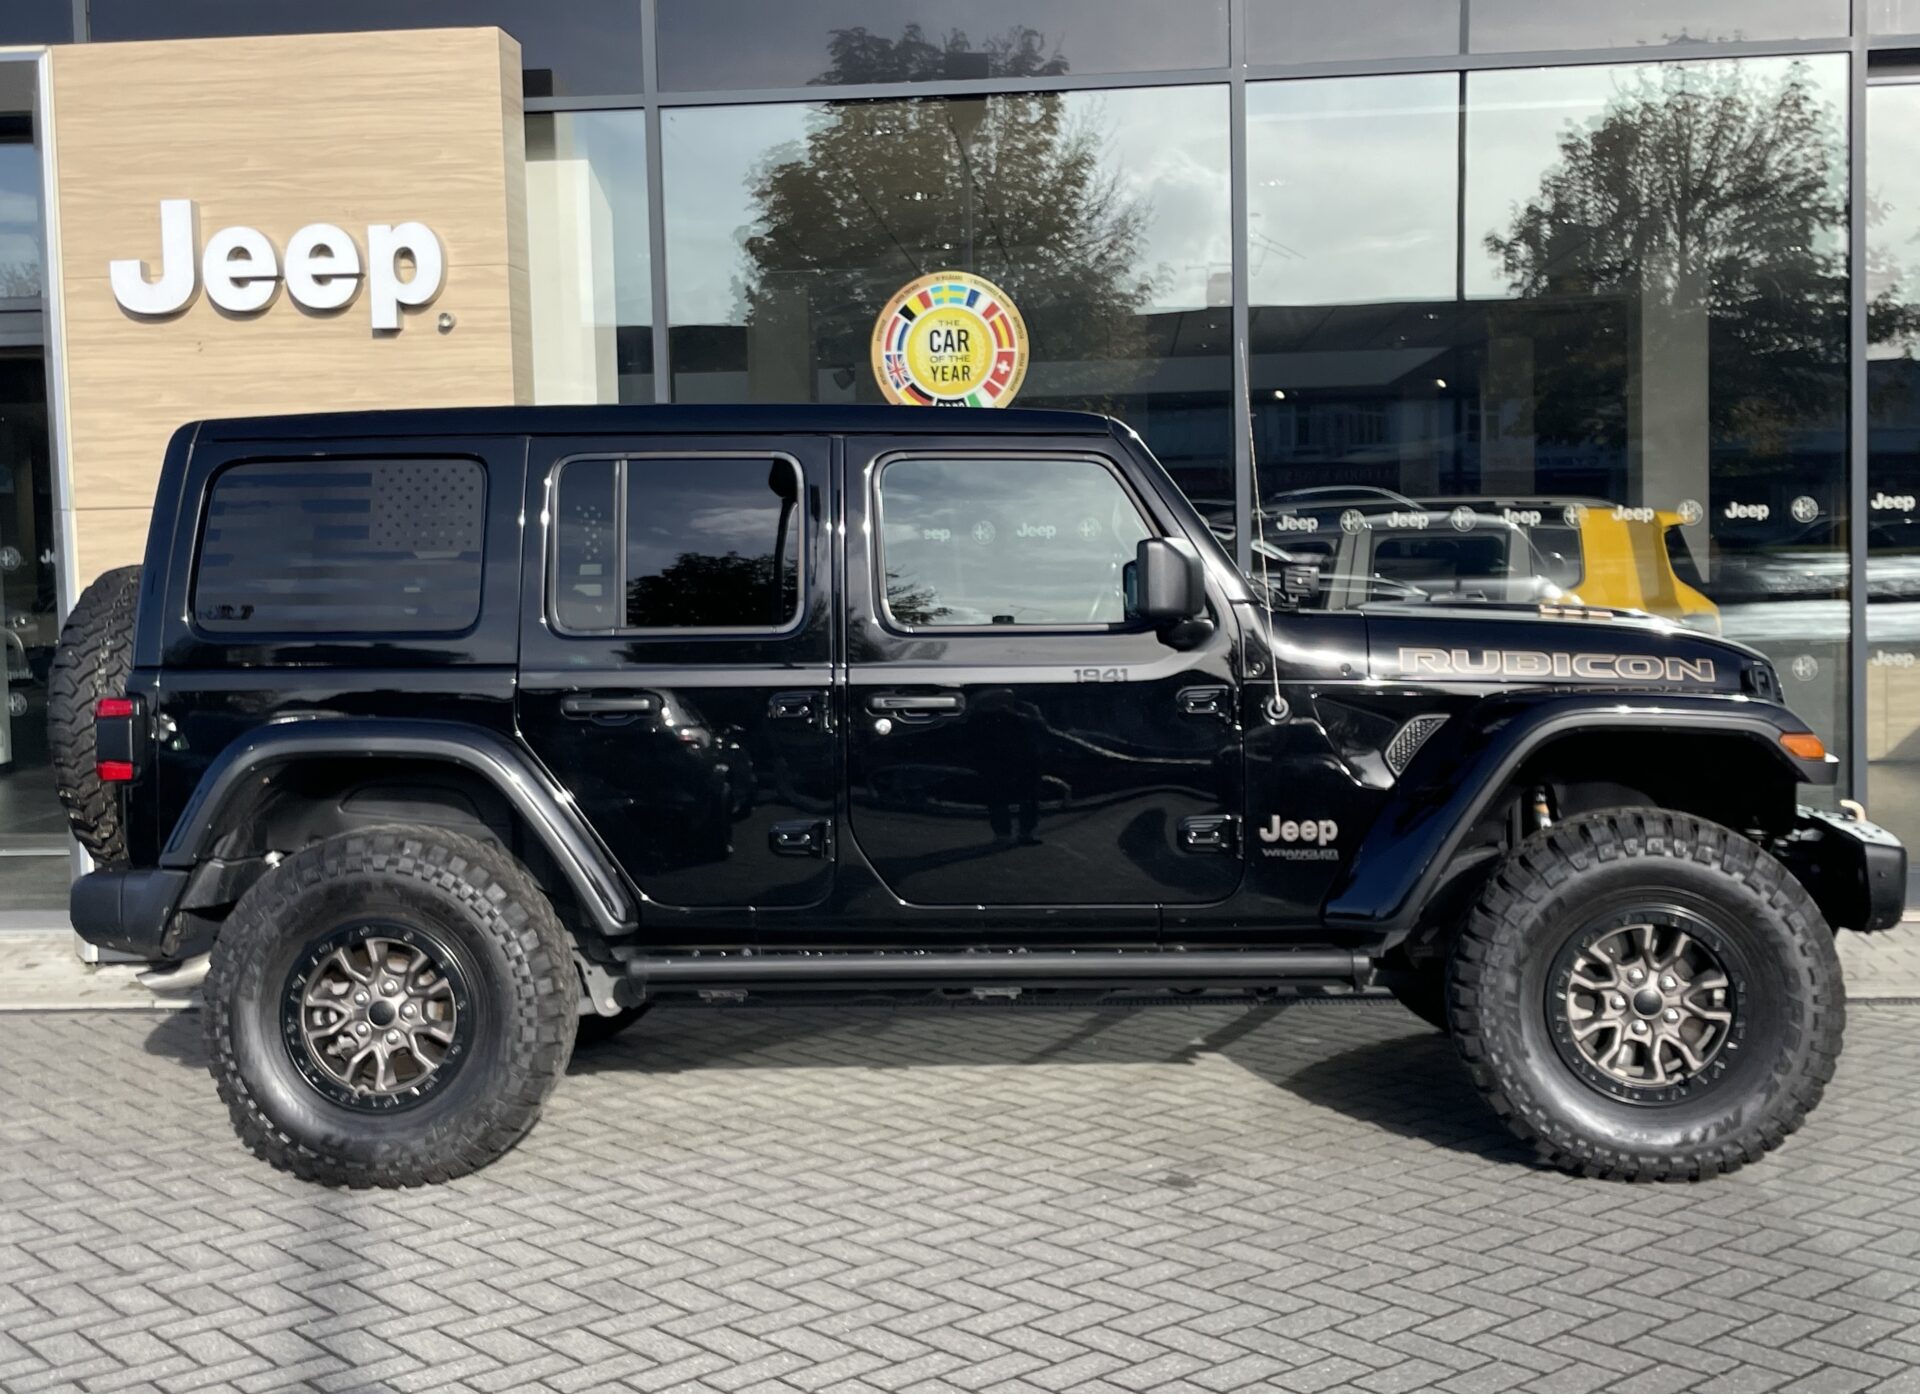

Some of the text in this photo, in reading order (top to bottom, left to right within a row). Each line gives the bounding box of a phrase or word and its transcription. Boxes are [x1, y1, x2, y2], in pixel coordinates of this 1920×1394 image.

[109, 199, 445, 331] Jeep
[938, 319, 960, 327] THE
[929, 329, 970, 353] CAR
[930, 354, 971, 364] OF THE
[930, 365, 971, 382] YEAR
[1725, 501, 1770, 521] Jeep
[1871, 492, 1916, 512] Jeep
[1387, 511, 1429, 529] Jeep
[1500, 507, 1542, 527] Jeep
[1612, 504, 1655, 523] Jeep
[1016, 522, 1057, 539] Jeep
[1276, 514, 1318, 532] Jeep
[924, 528, 951, 542] eep
[1399, 647, 1716, 683] RUBICON
[1872, 650, 1916, 668] Jeep
[1073, 667, 1128, 683] 1941
[1260, 814, 1338, 846] Jeep
